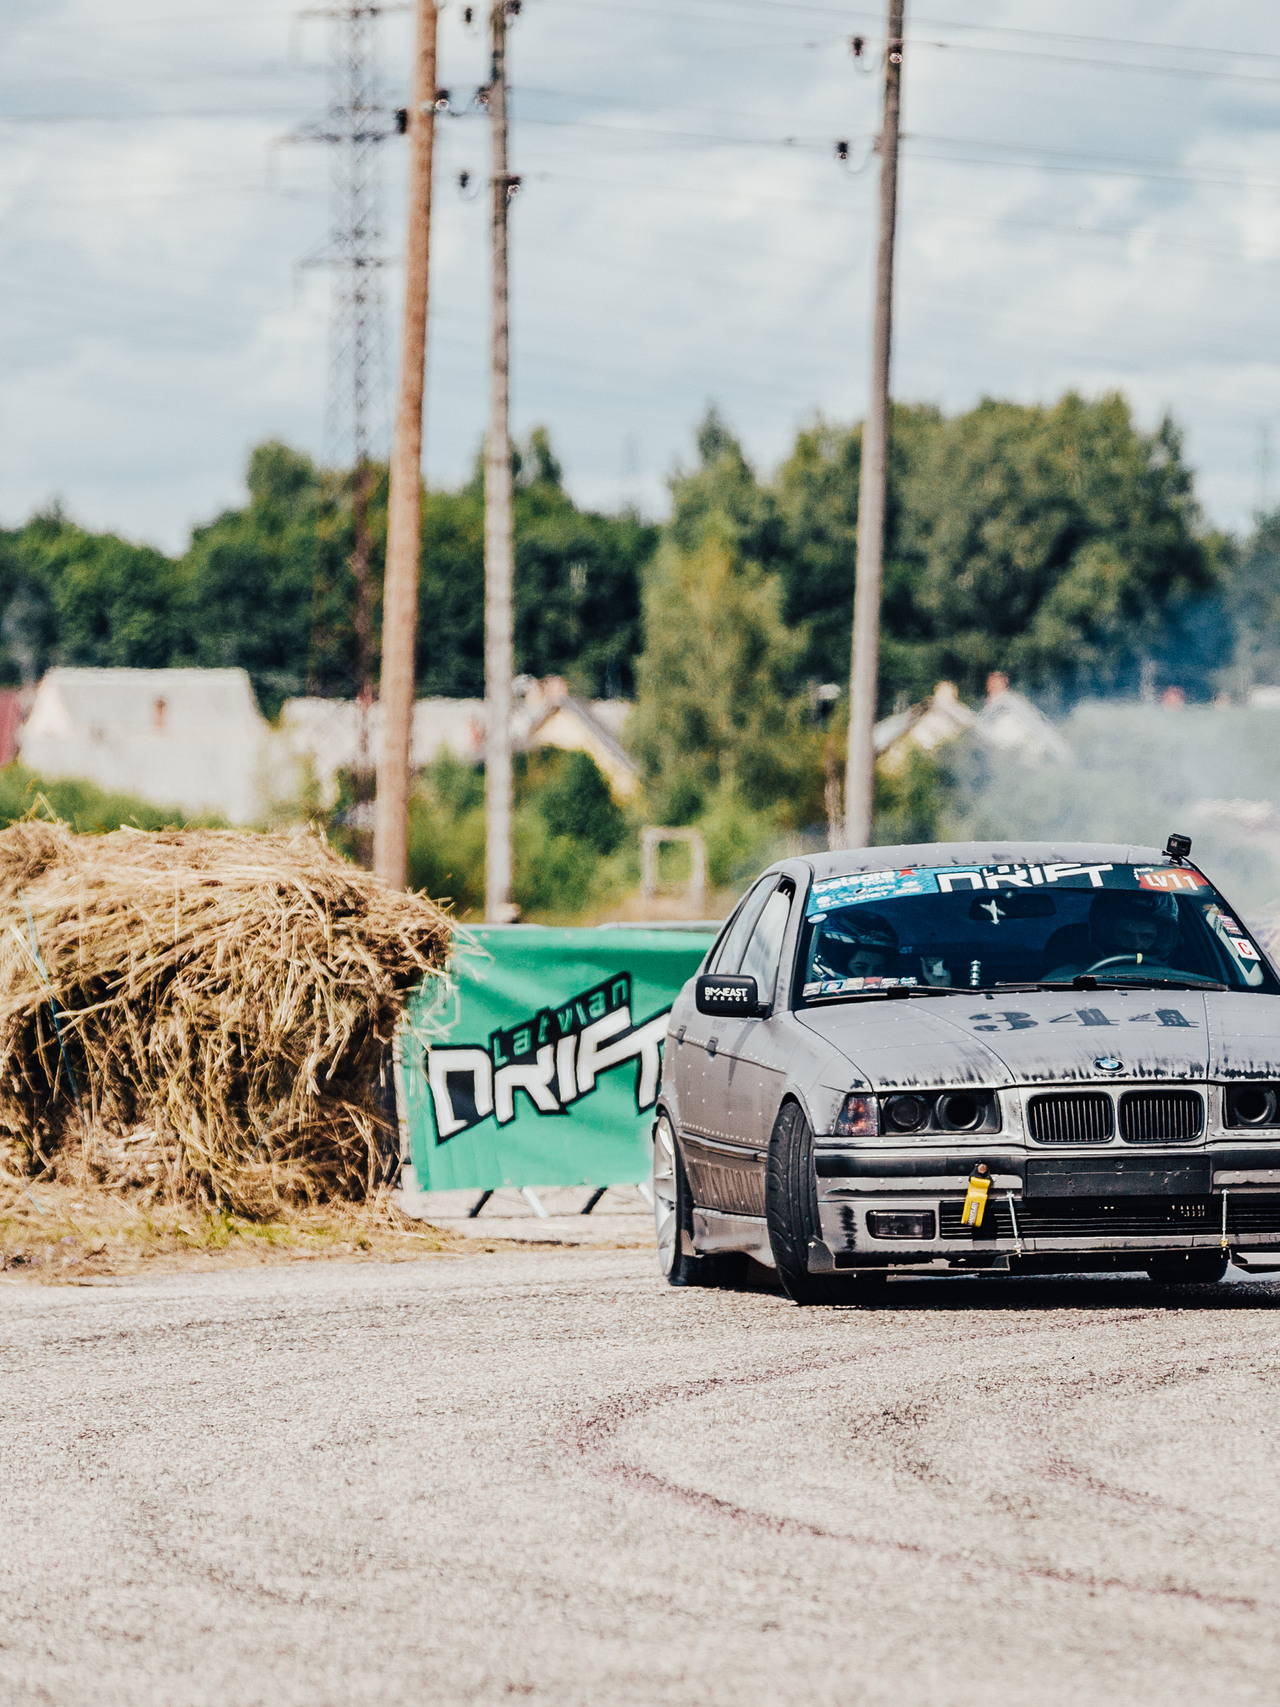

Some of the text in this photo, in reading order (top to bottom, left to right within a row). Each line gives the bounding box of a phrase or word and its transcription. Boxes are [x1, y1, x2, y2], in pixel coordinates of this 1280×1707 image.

[936, 863, 1114, 894] DRIFT
[1144, 872, 1200, 891] LV11
[1237, 941, 1253, 956] C
[968, 1007, 1200, 1032] 344
